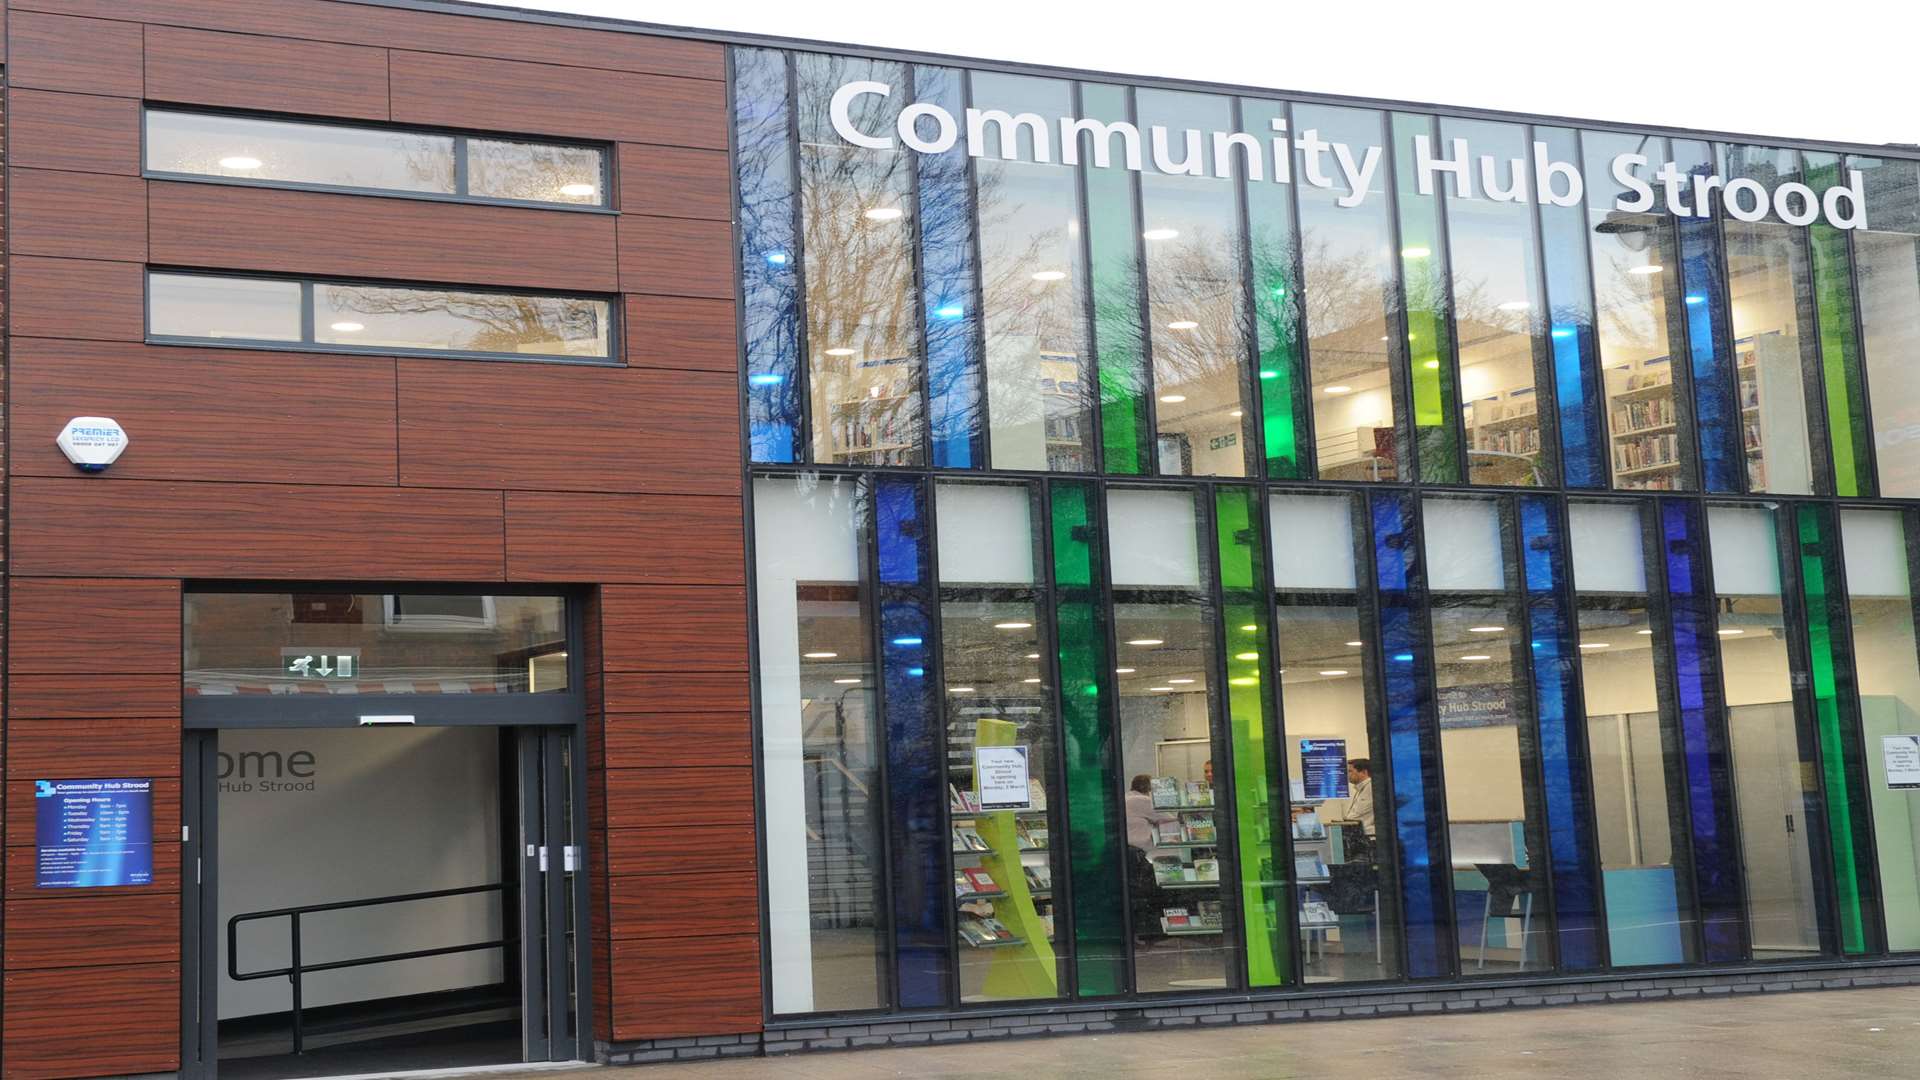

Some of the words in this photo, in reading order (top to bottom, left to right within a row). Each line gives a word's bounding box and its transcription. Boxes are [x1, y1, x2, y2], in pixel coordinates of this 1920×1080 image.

[829, 81, 1382, 208] Community
[1414, 135, 1584, 207] Hub
[1612, 153, 1869, 230] Strood
[72, 427, 120, 436] PREMIER
[1448, 702, 1469, 713] Hub
[1471, 698, 1506, 711] Strood
[56, 783, 102, 791] Community
[122, 781, 149, 789] Strood
[219, 781, 253, 793] Hub
[259, 780, 315, 792] Strood
